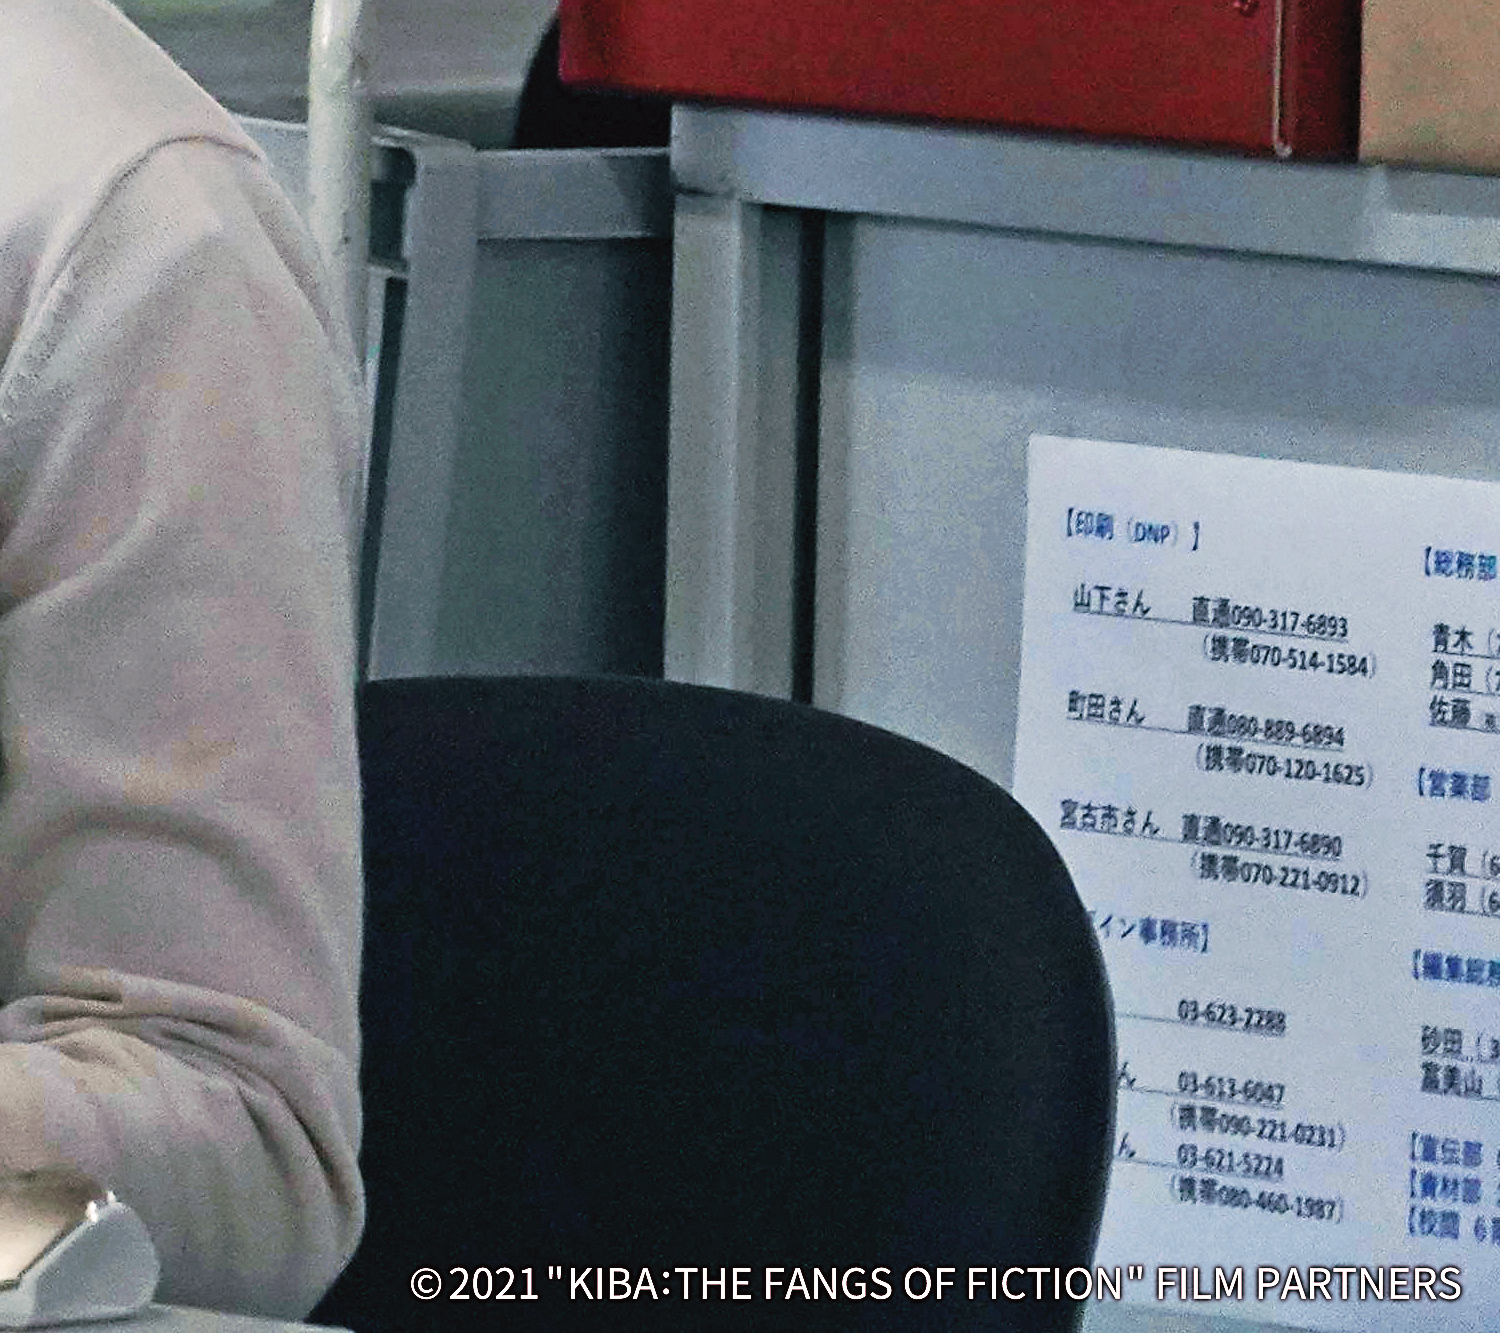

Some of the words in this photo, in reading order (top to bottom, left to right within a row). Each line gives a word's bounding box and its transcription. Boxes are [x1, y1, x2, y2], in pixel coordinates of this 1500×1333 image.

[1073, 583, 1151, 616] 山下さん
[1068, 689, 1146, 725] 町田さん
